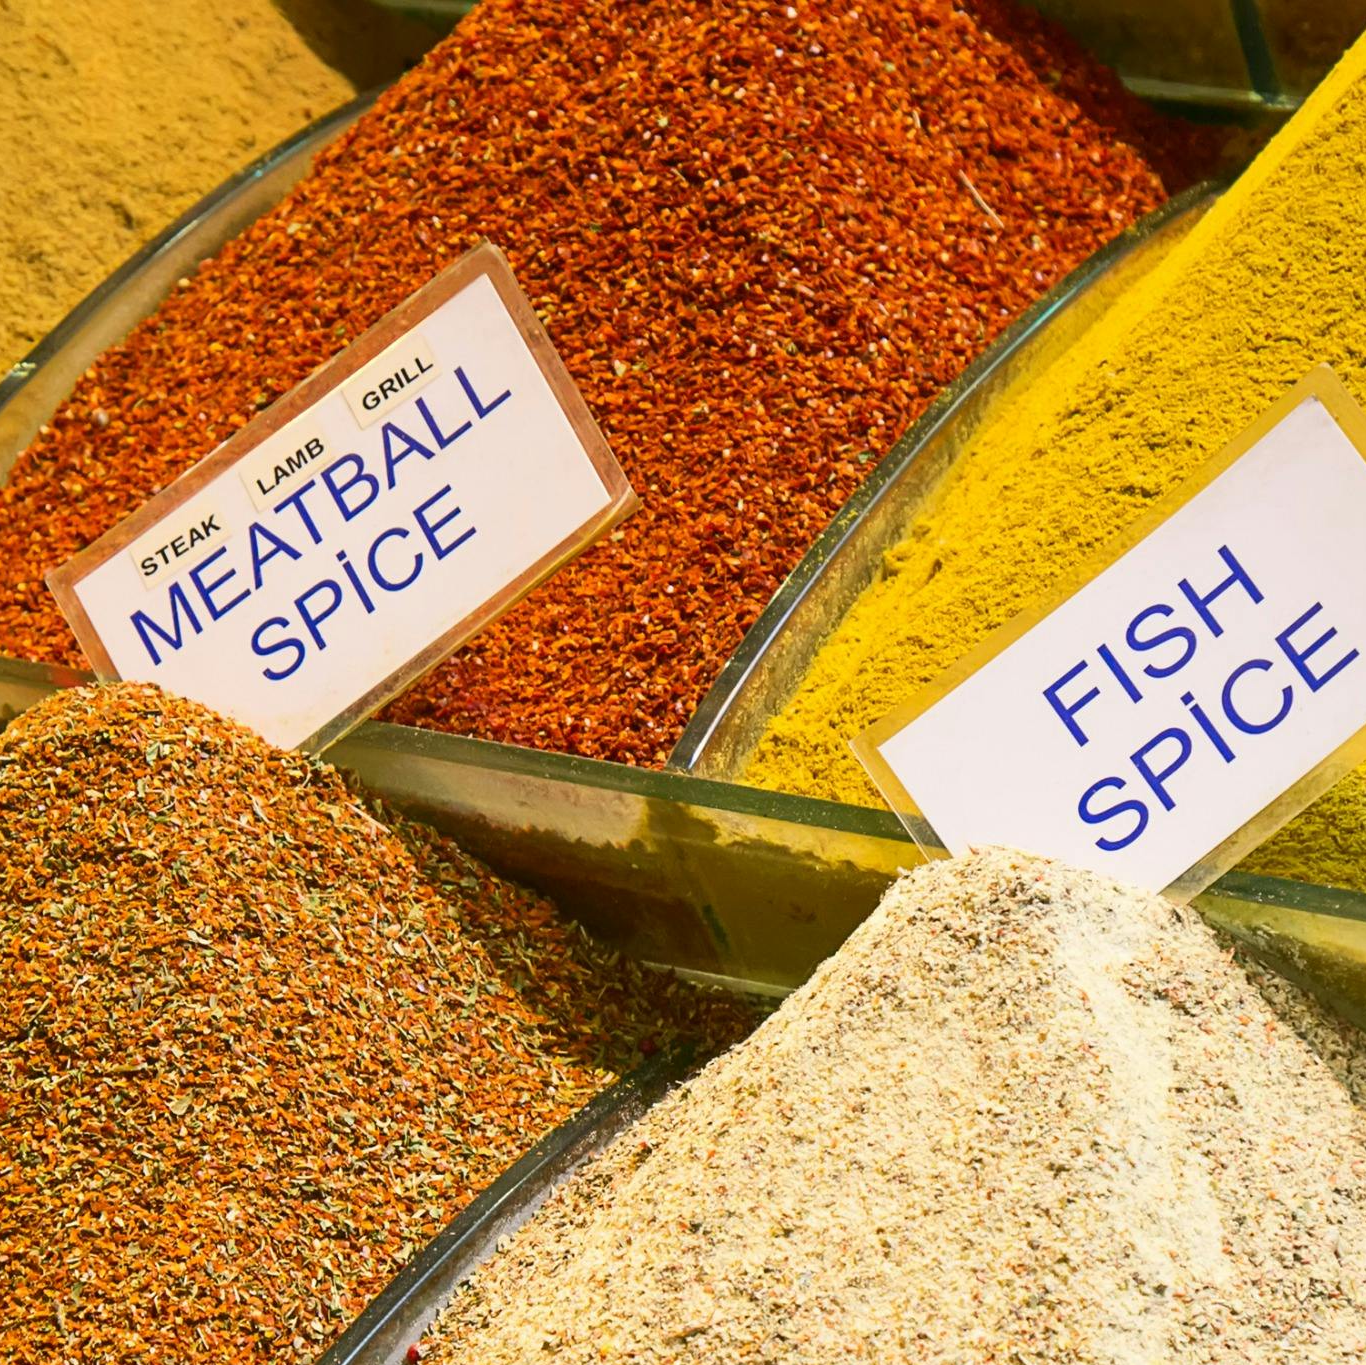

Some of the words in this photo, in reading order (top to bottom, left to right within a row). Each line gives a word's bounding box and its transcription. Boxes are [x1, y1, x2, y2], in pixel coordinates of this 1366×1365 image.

[128, 366, 512, 666] MEATBALL
[140, 513, 221, 578] STEAK
[256, 437, 326, 496] LAMB
[361, 356, 434, 412] GRILL
[1041, 544, 1265, 747] FISH
